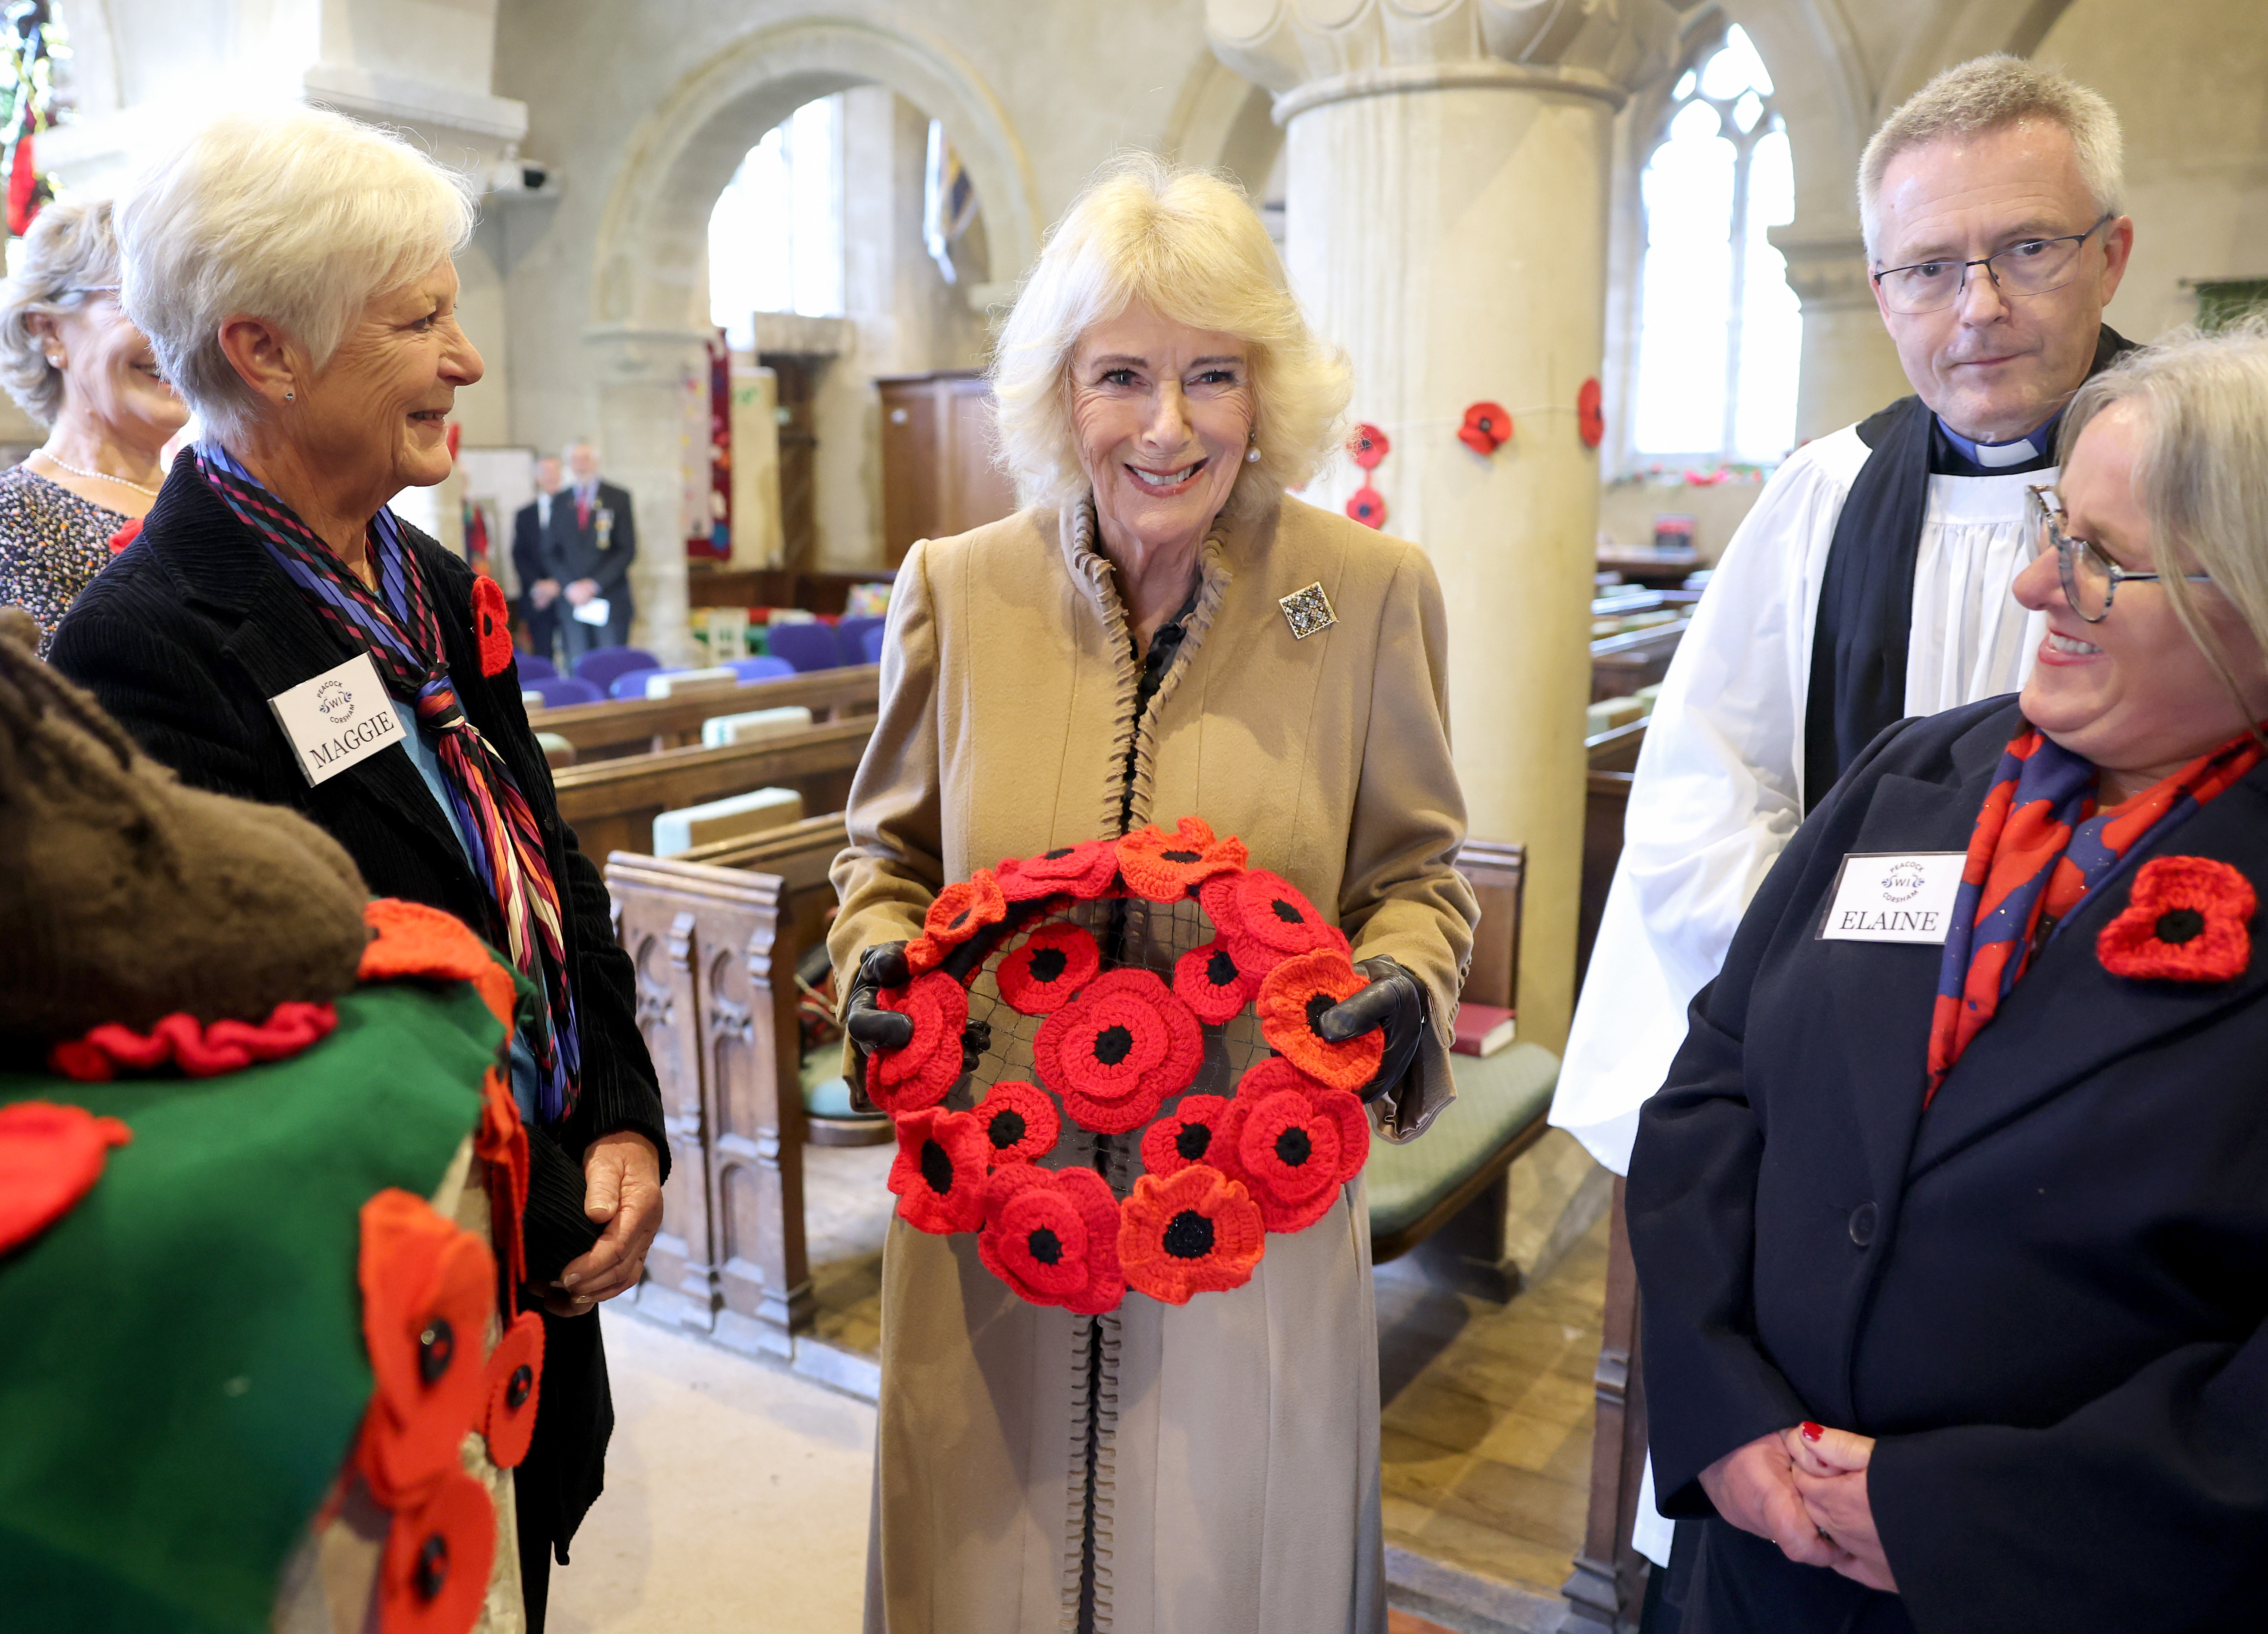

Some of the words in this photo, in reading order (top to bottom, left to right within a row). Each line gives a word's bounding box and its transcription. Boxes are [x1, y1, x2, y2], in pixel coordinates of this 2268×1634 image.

[317, 680, 342, 698] PEACOCK
[329, 696, 344, 708] WI
[330, 704, 355, 723] CORSHAM
[309, 711, 394, 769] MAGGIE
[1890, 861, 1924, 873] PEACOCK
[1895, 878, 1912, 887] WI
[1883, 890, 1919, 903] CORSHAM
[1839, 911, 1939, 931] ELAINE
